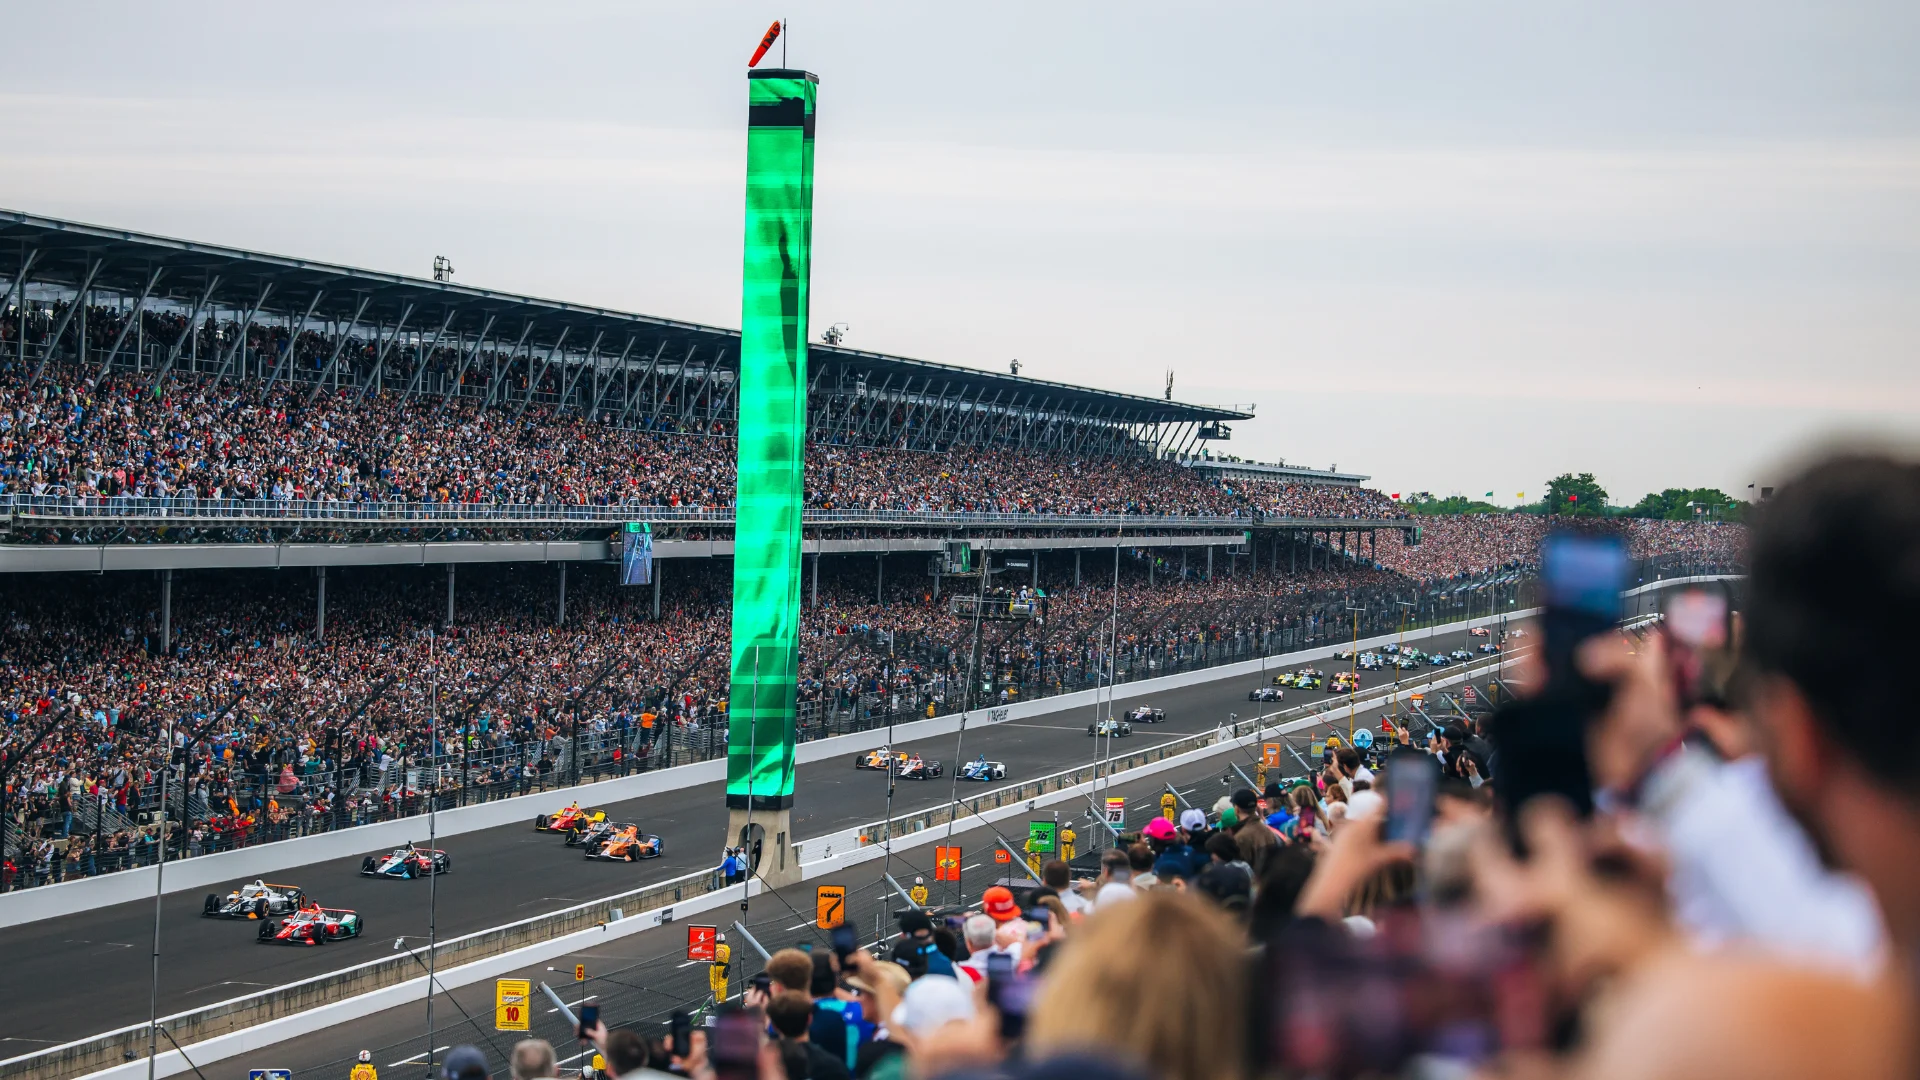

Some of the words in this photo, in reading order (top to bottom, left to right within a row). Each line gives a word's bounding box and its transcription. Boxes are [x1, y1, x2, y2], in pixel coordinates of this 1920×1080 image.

[761, 23, 781, 50] IMS
[1464, 688, 1475, 697] 28
[1108, 811, 1121, 822] 75
[1035, 830, 1049, 840] 76
[820, 892, 842, 922] 7
[698, 931, 705, 942] 4
[506, 1006, 519, 1022] 10
